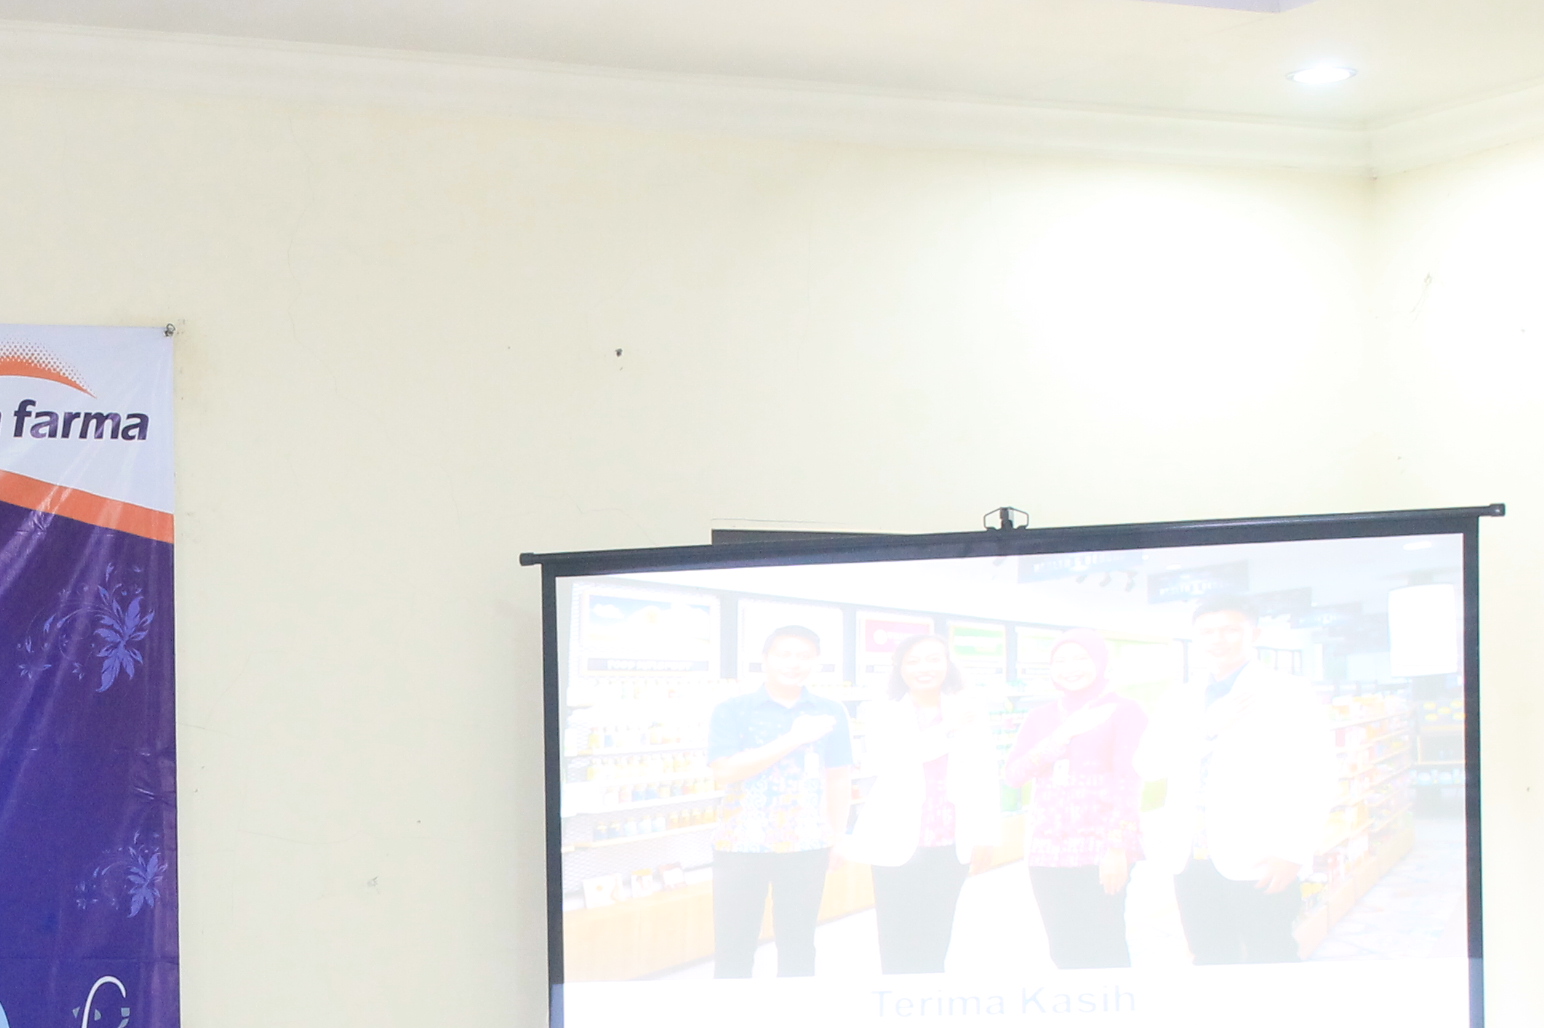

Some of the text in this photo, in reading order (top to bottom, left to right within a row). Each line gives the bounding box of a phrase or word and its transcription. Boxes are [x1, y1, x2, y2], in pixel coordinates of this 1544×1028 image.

[12, 398, 150, 441] farma
[869, 984, 1138, 1018] Terima Kasih
